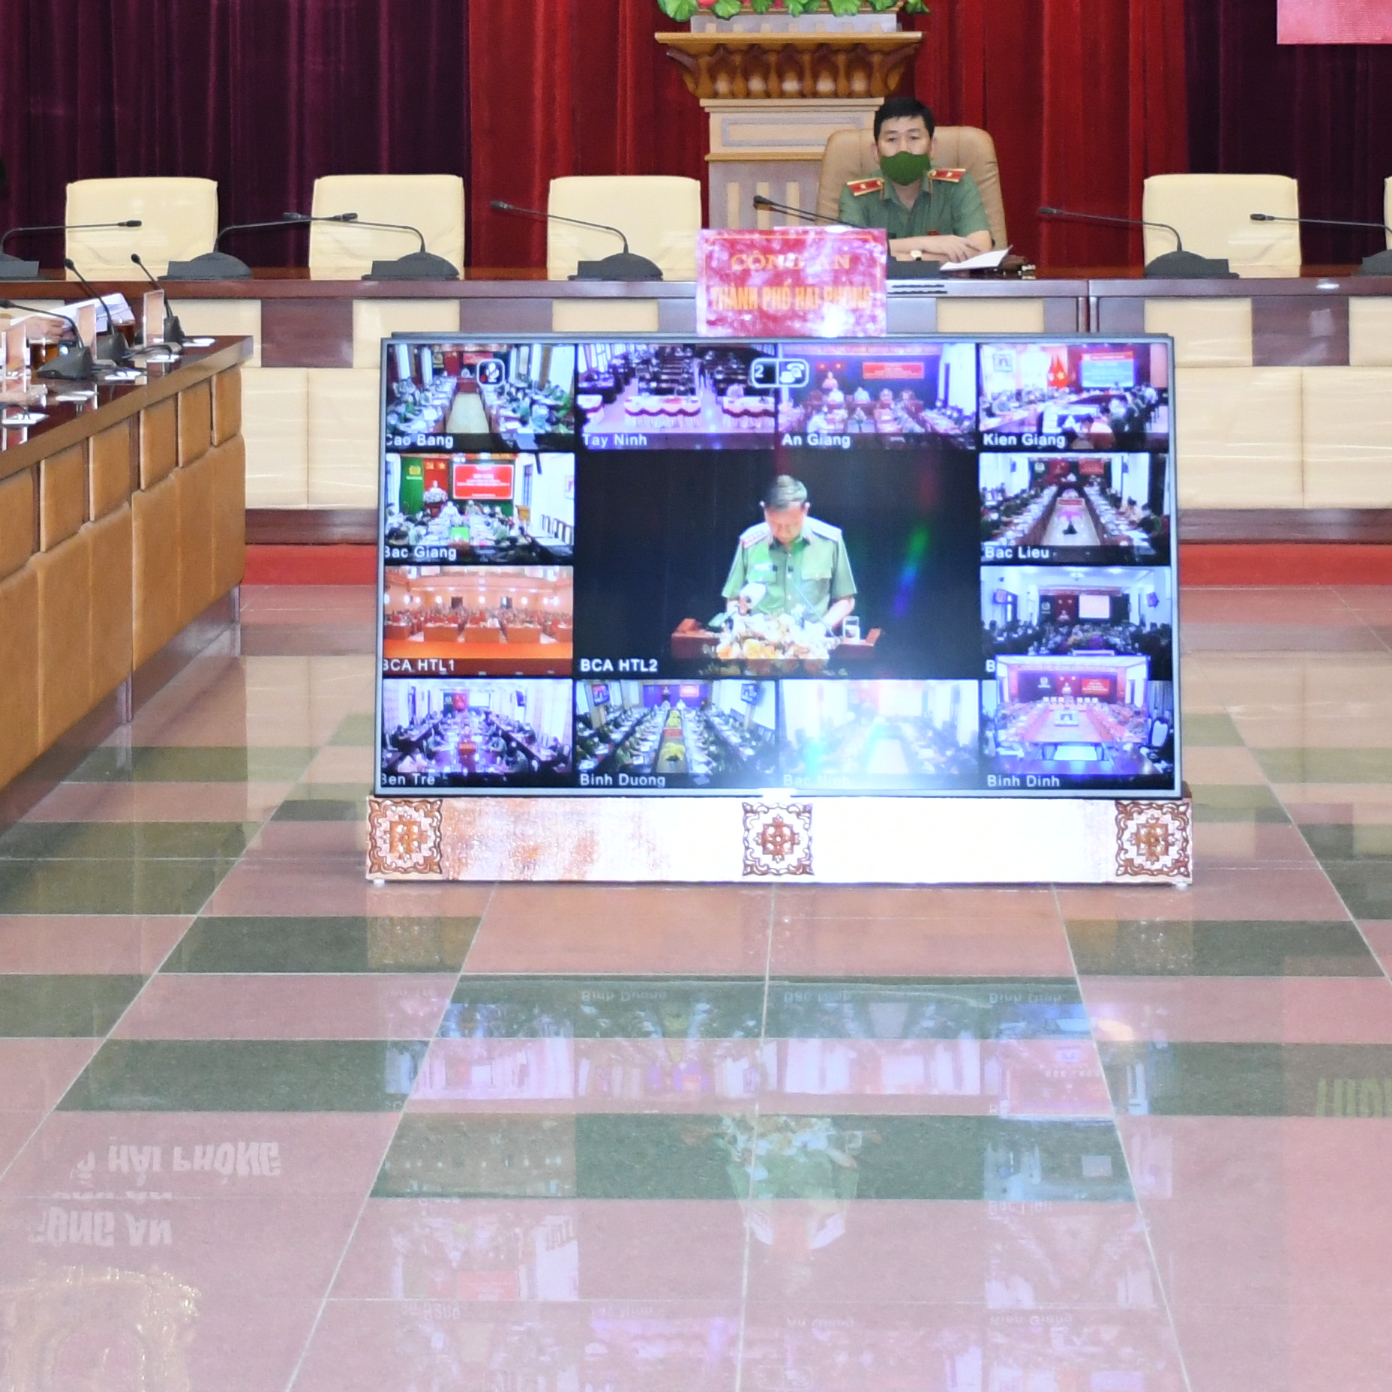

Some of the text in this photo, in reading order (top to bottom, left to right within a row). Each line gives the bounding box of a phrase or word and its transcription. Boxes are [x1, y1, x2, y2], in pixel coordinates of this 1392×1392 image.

[754, 364, 764, 378] 2
[416, 434, 454, 449] Bang
[583, 433, 647, 449] Tay Ninh
[782, 433, 851, 449] An Giang
[983, 433, 1066, 450] Kien Giang
[414, 546, 457, 561] Giang
[984, 546, 1050, 559] Bac Lieu
[418, 659, 455, 672] HTL1
[580, 659, 658, 672] BCA HTL2
[411, 773, 435, 786] Tre
[580, 773, 665, 788] Binh Duong
[987, 773, 1060, 787] Binh Dinh
